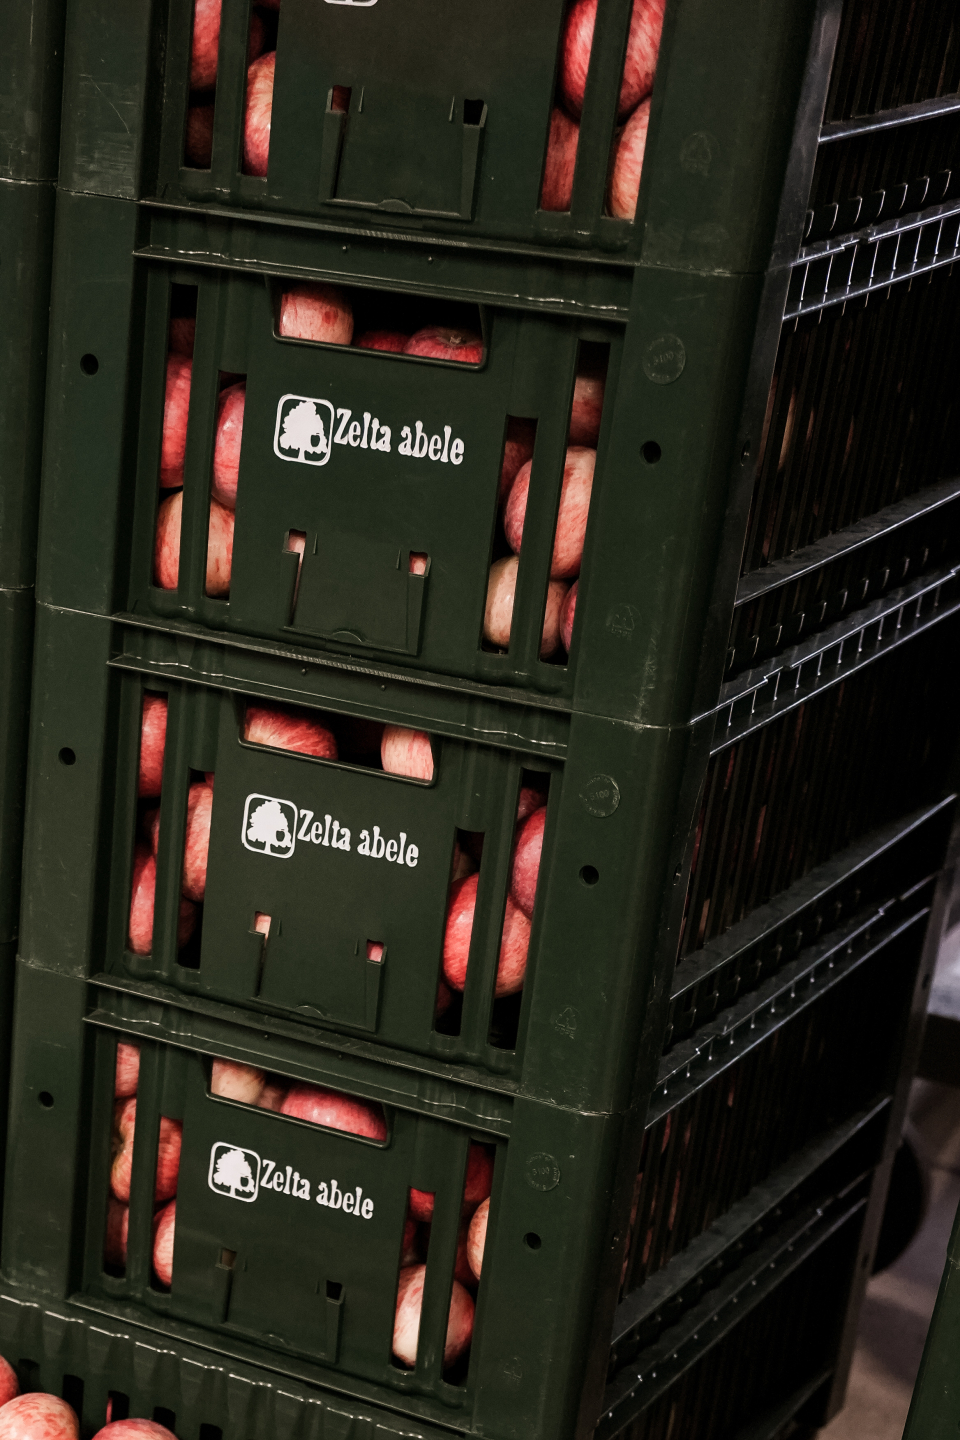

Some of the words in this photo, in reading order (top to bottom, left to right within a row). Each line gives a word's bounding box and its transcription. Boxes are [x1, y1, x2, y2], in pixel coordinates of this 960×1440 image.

[334, 407, 392, 453] Zelta
[297, 808, 351, 852] Zelta
[260, 1159, 311, 1201] Zelta
